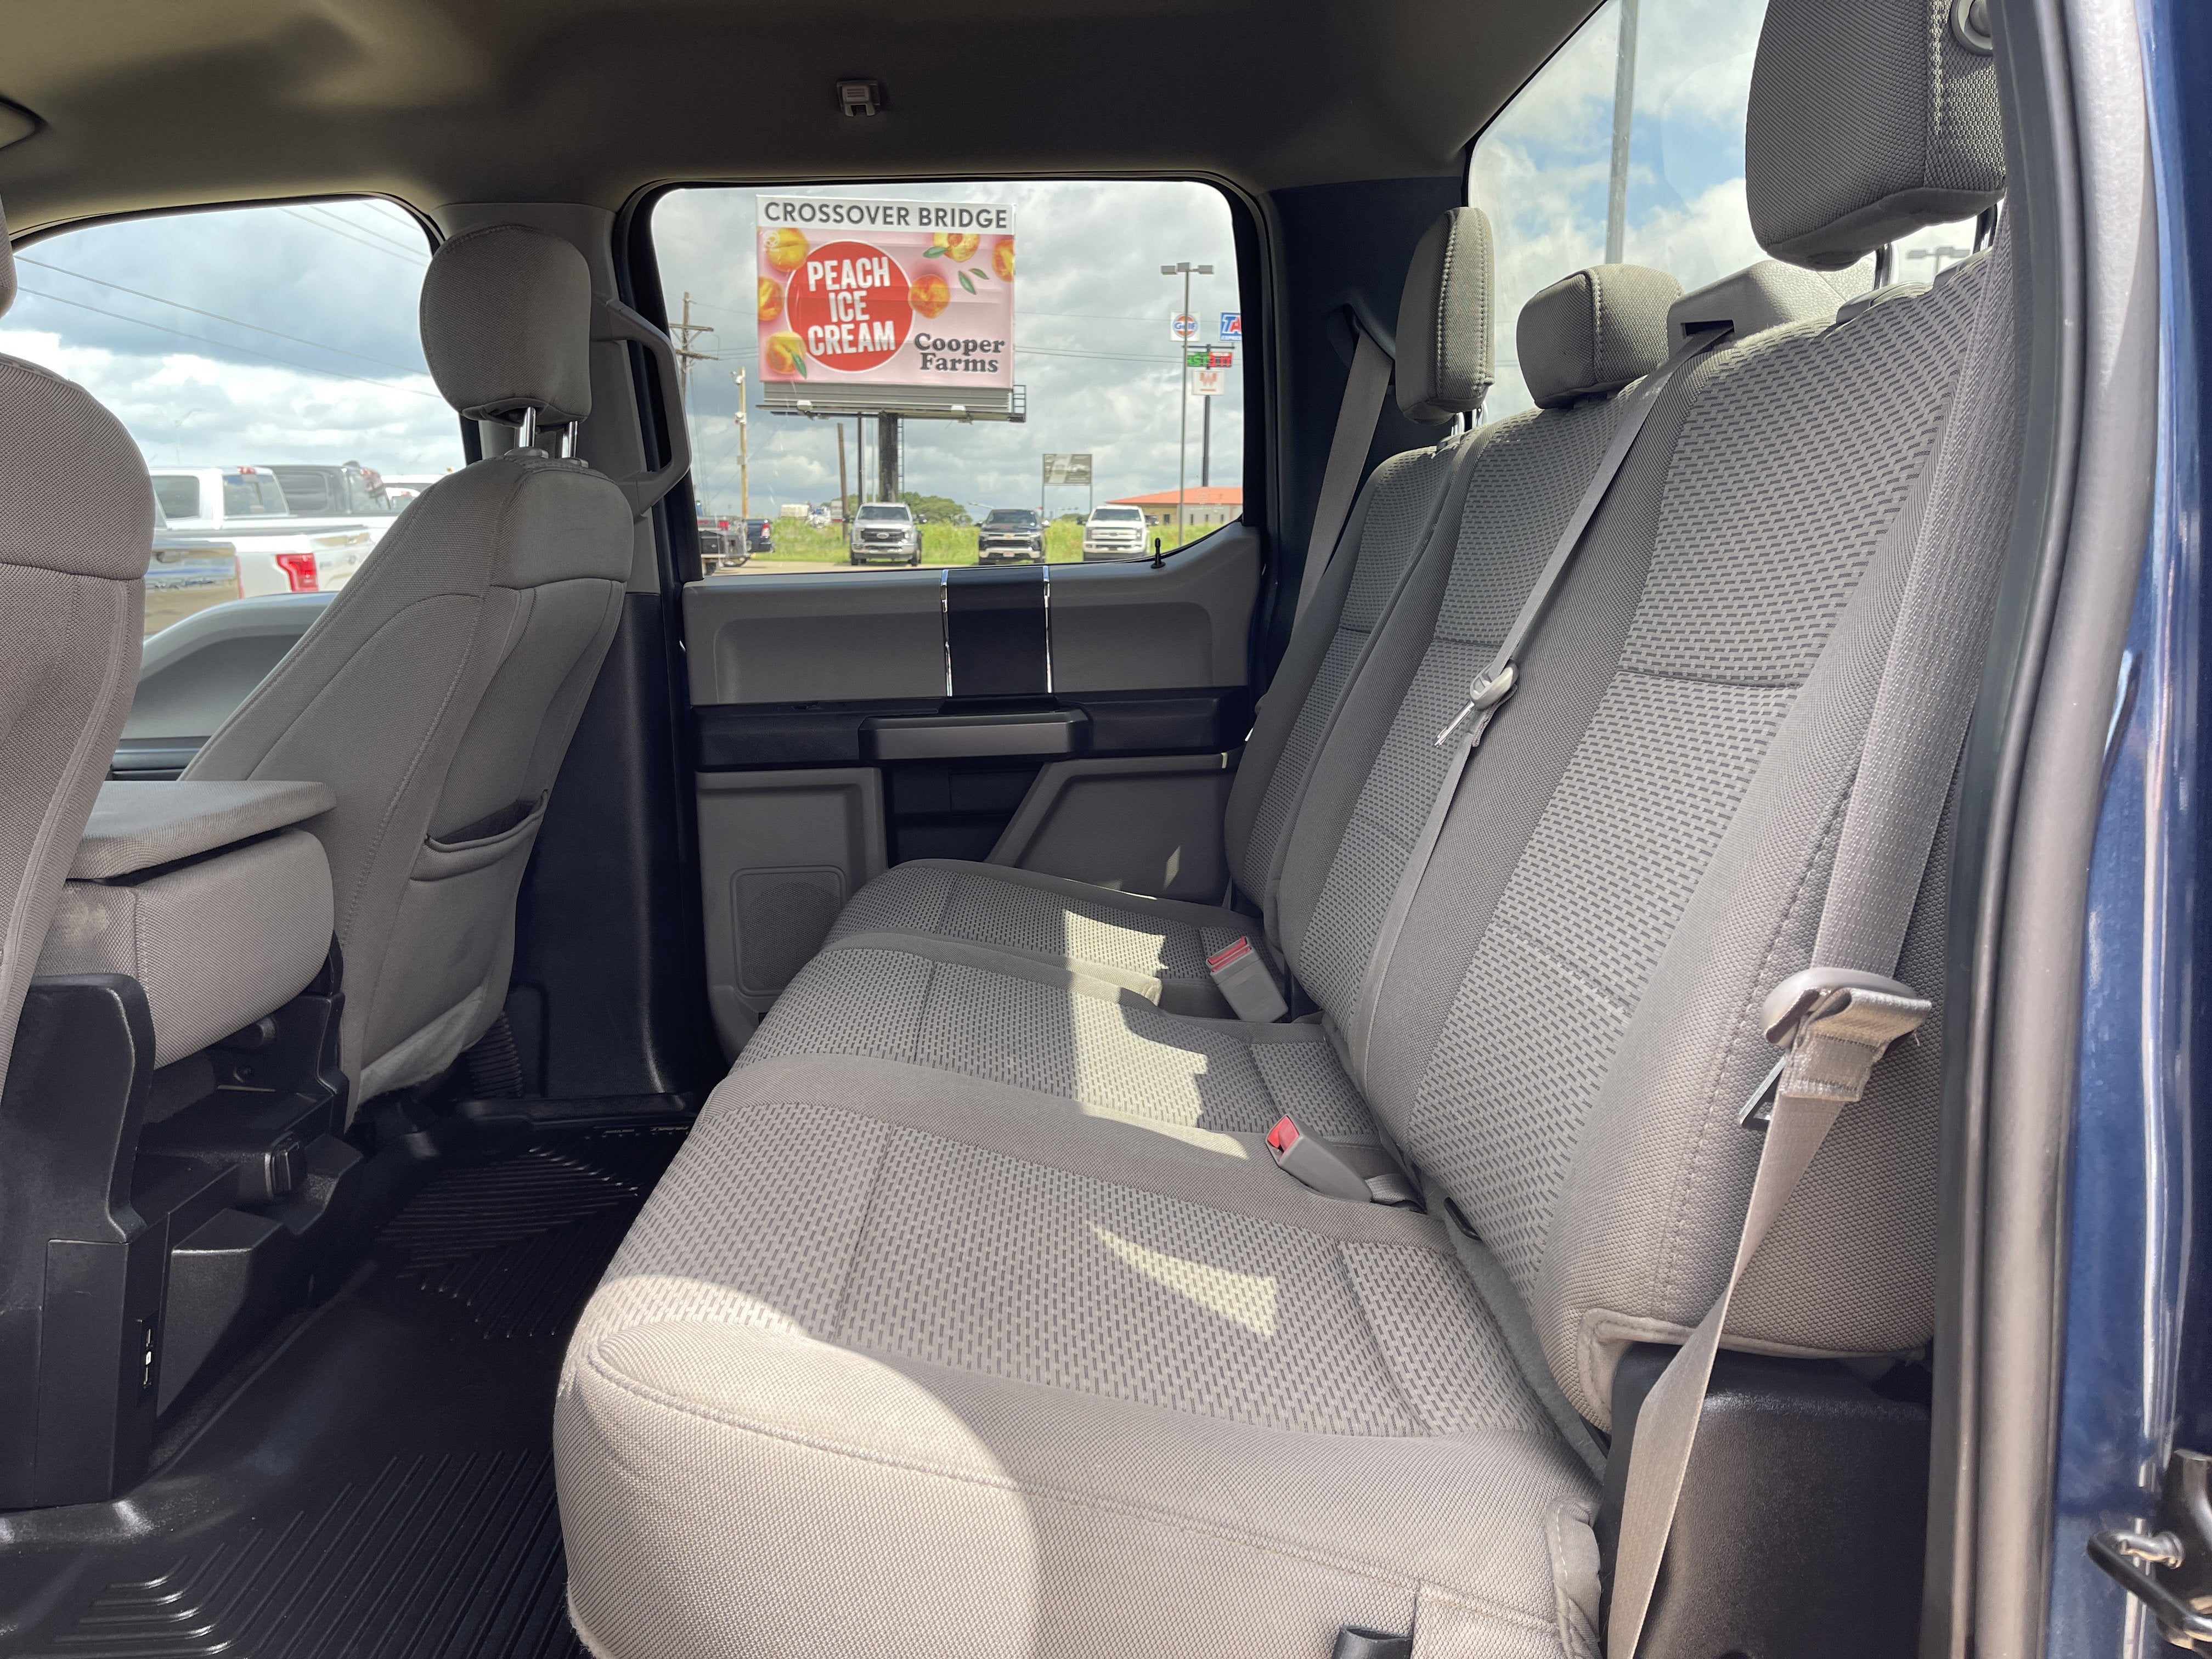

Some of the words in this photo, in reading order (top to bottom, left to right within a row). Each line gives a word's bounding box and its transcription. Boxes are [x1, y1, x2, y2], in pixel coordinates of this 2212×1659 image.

[764, 202, 910, 226] CROSSOVER
[918, 207, 1007, 229] BRIDGE
[806, 256, 891, 292] PEACH
[828, 291, 870, 323] ICE
[807, 320, 896, 356] CREAM
[915, 332, 1005, 356] Cooper
[920, 352, 998, 373] Farms
